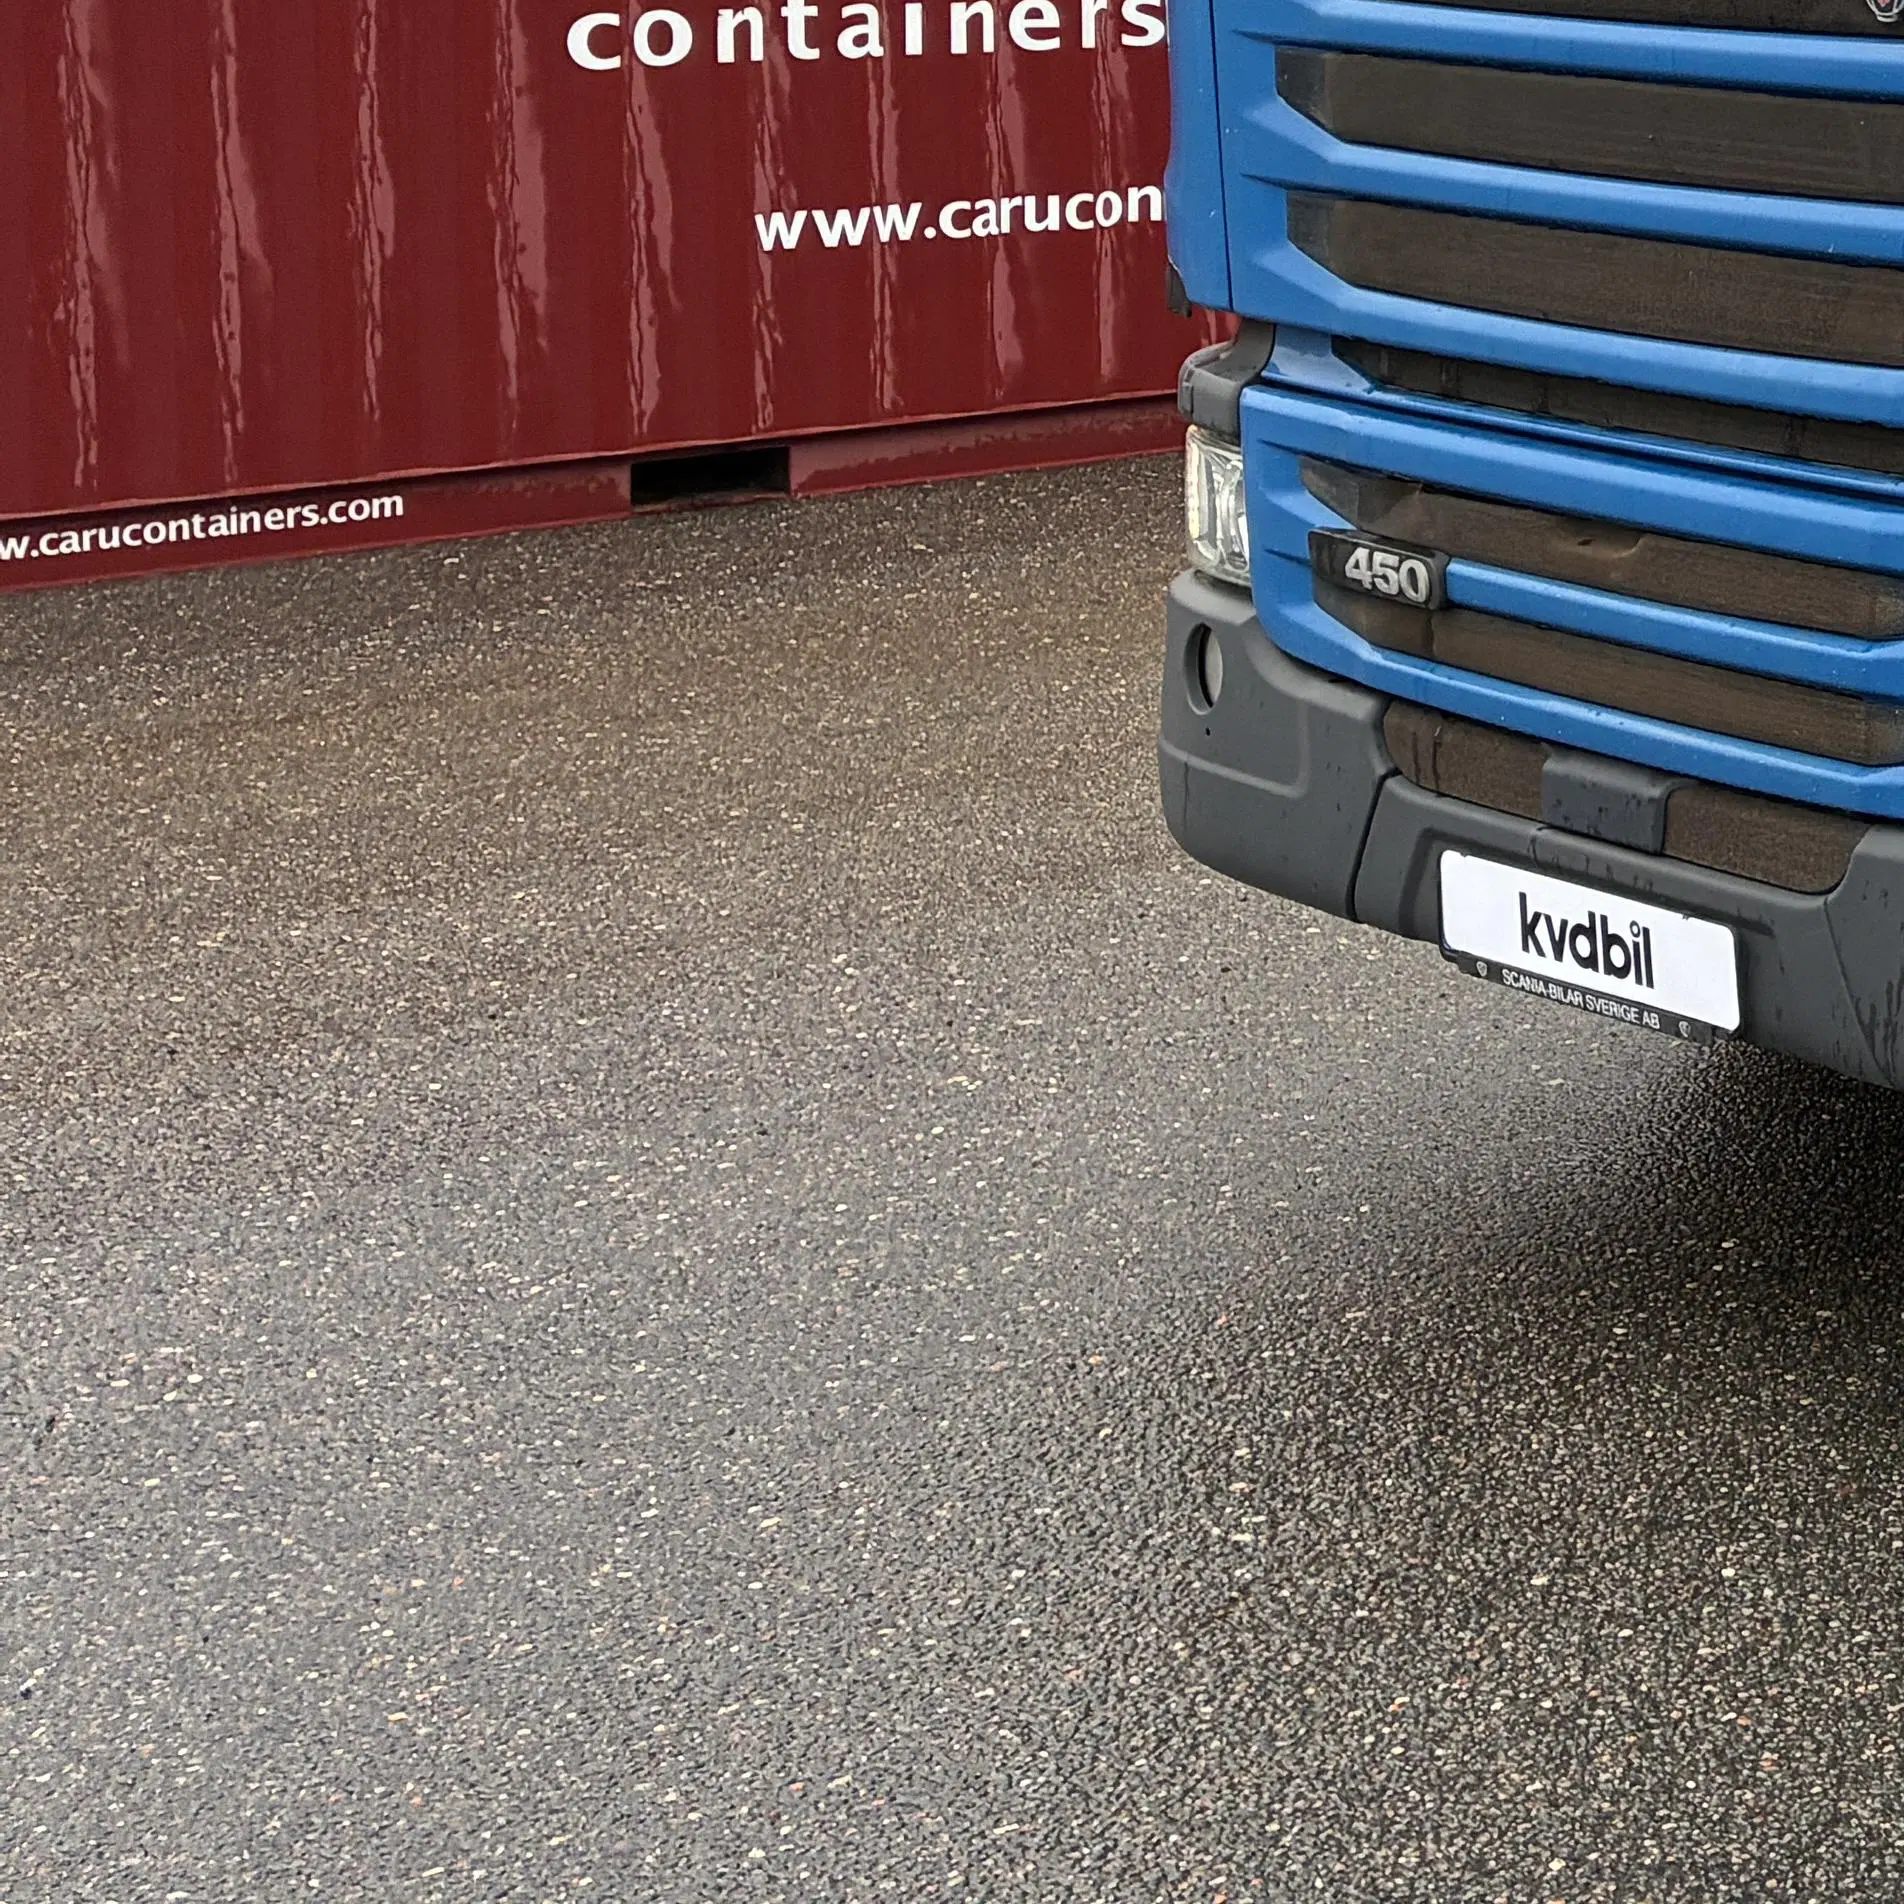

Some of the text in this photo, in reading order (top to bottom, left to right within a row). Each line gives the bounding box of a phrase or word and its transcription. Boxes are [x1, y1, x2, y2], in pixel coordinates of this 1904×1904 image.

[1344, 546, 1430, 603] 450
[1518, 891, 1655, 989] kvdbil
[1585, 994, 1640, 1024] SVERIGE
[1642, 1011, 1660, 1030] AB
